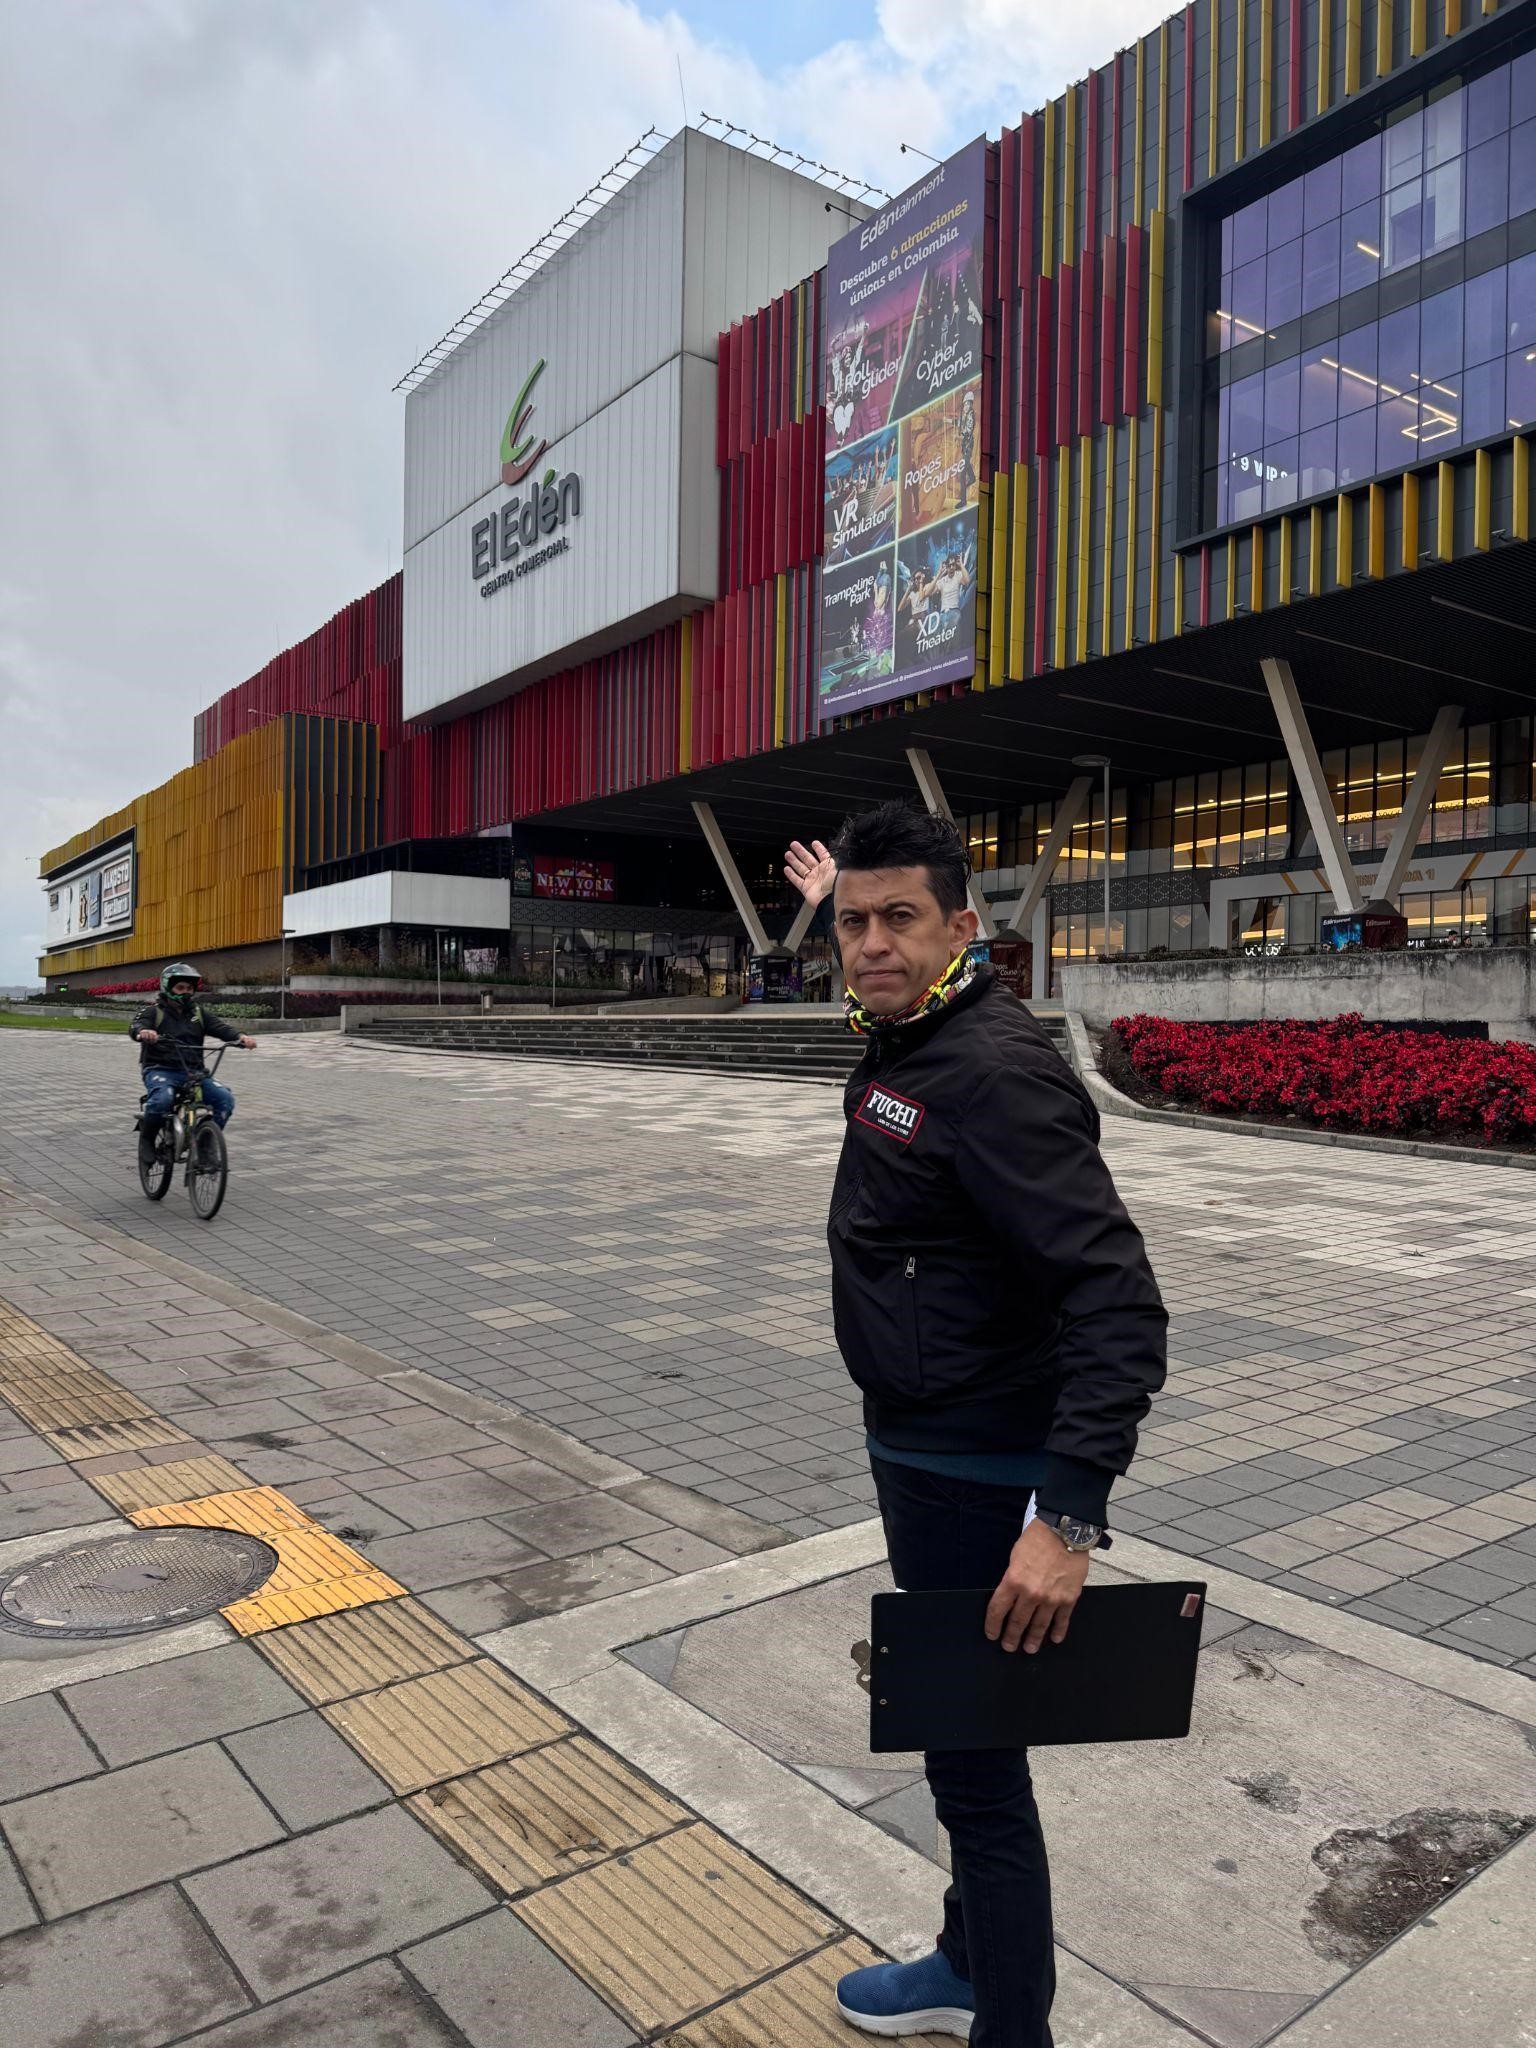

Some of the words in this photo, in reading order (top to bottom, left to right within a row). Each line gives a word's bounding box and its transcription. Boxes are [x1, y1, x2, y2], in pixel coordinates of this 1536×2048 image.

[839, 254, 888, 295] Descubre
[890, 246, 899, 261] 6
[900, 197, 969, 257] atracciones
[849, 276, 886, 307] únicas
[887, 265, 903, 283] en
[903, 226, 960, 271] Colombia
[844, 359, 870, 394] Roll
[861, 355, 902, 399] glider
[916, 339, 959, 382] Cyber
[928, 349, 973, 394] Arena
[904, 453, 942, 490] Ropes
[924, 457, 967, 494] Course
[472, 511, 497, 580] El
[500, 468, 581, 562] Edén
[831, 508, 889, 550] Simulator
[833, 498, 859, 533] VR
[481, 565, 514, 598] CENTRO
[515, 536, 570, 578] COMERCIAL
[824, 574, 875, 609] Trampoline
[849, 587, 872, 608] Park
[915, 625, 957, 656] Theater
[917, 611, 941, 641] XD
[575, 878, 615, 891] YORK
[867, 1090, 918, 1128] FUCHI
